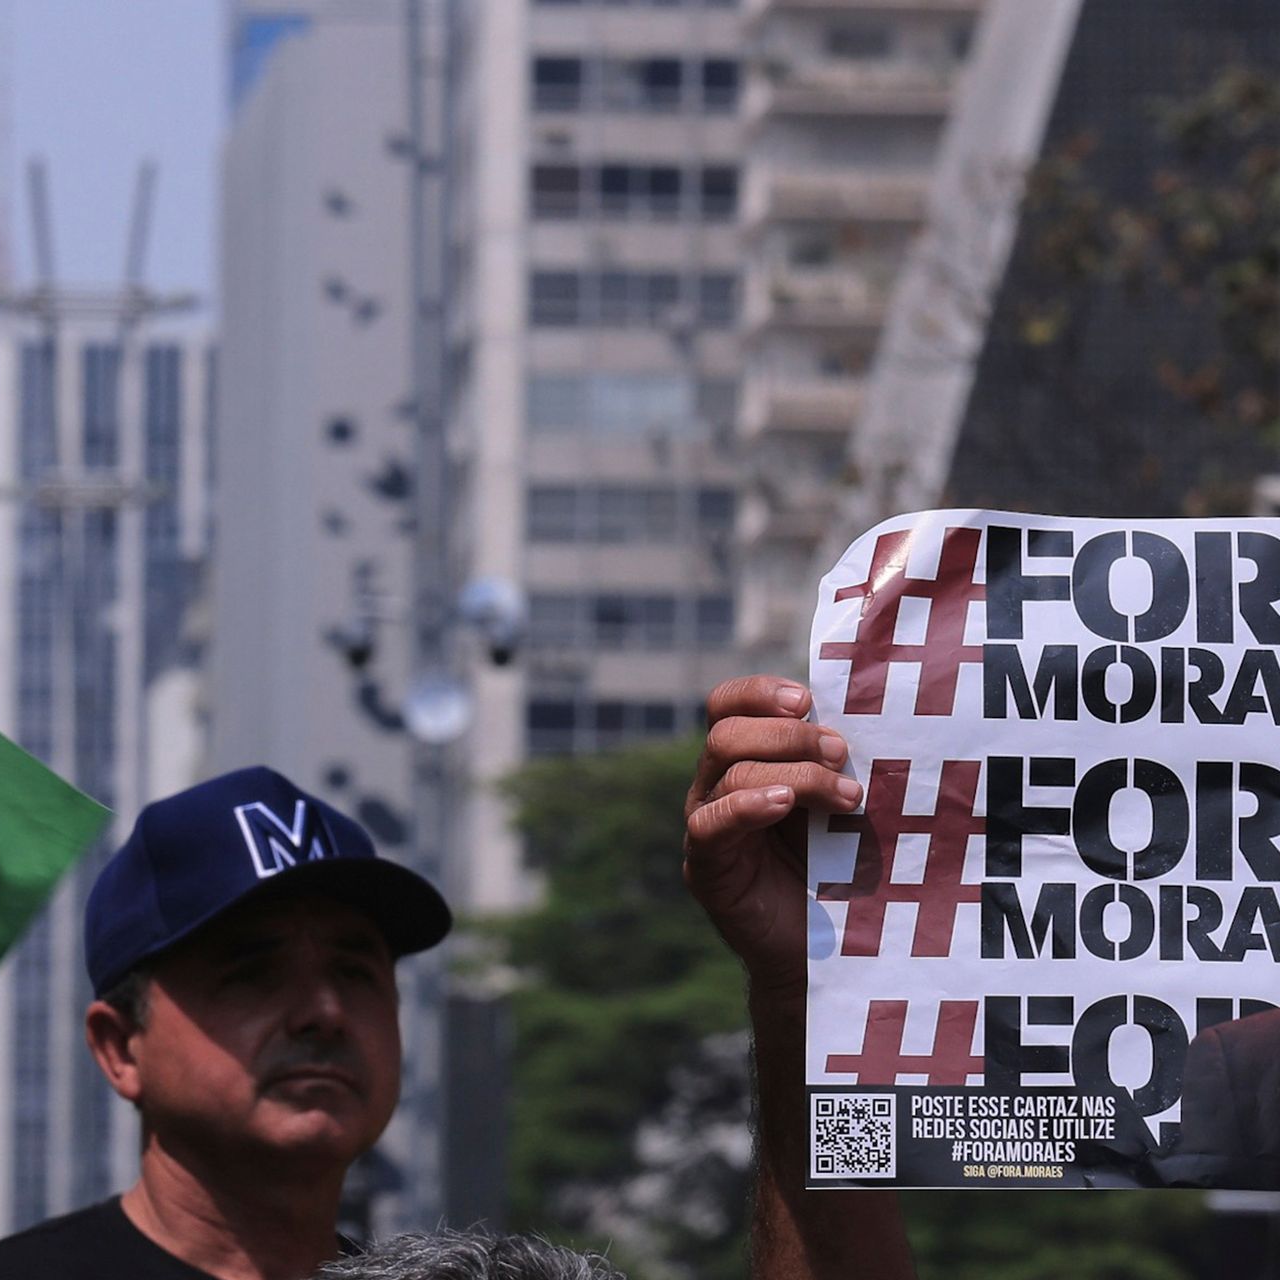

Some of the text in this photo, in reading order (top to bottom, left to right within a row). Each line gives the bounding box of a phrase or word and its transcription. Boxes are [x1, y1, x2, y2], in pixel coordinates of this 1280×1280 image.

[911, 1096, 1116, 1118] POSTE ESSE CARTAZ NAS
[912, 1118, 1116, 1140] REDES SOCIAIS E UTILIZE
[952, 1141, 1076, 1163] #FORAMORAES
[963, 1165, 1064, 1179] SIGA @FORA.MORAES
